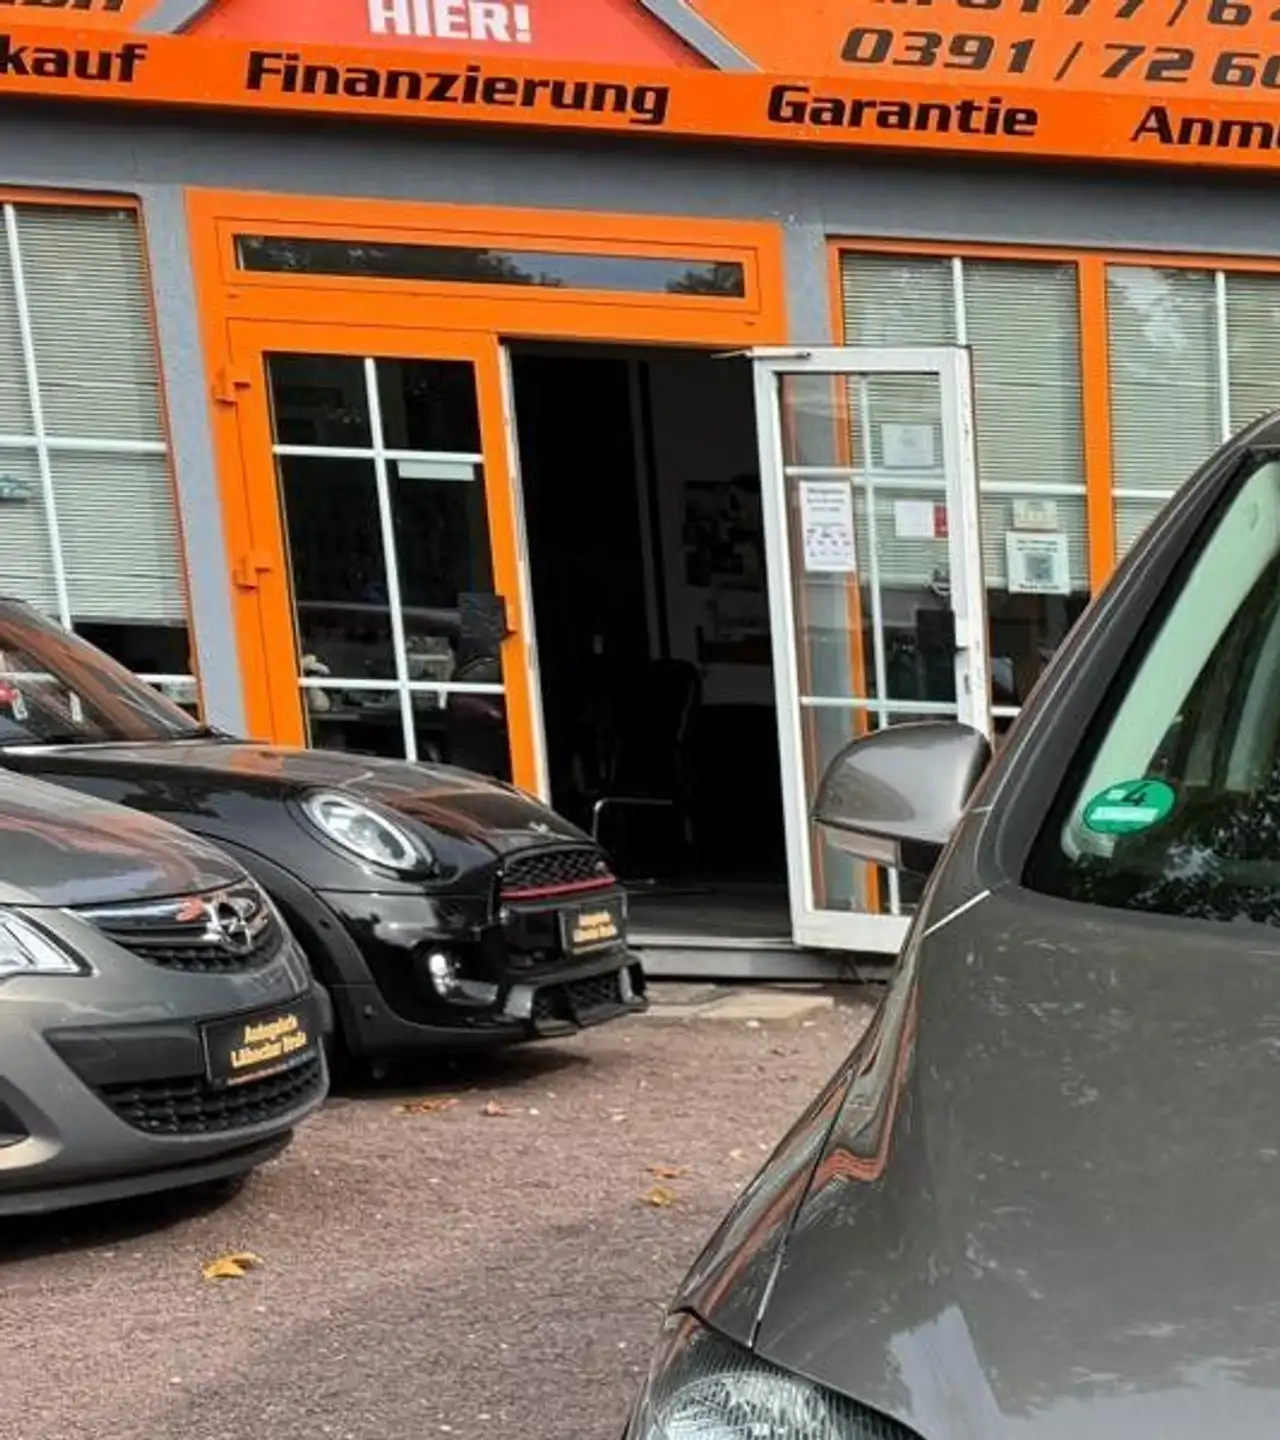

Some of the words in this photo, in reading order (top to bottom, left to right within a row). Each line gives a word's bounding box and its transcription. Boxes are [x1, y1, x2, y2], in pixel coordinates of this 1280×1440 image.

[368, 0, 532, 43] HIER!
[840, 27, 1037, 74] 0391
[1101, 43, 1195, 83] 72
[245, 50, 670, 125] Finanzierung
[767, 84, 1038, 136] Garantie
